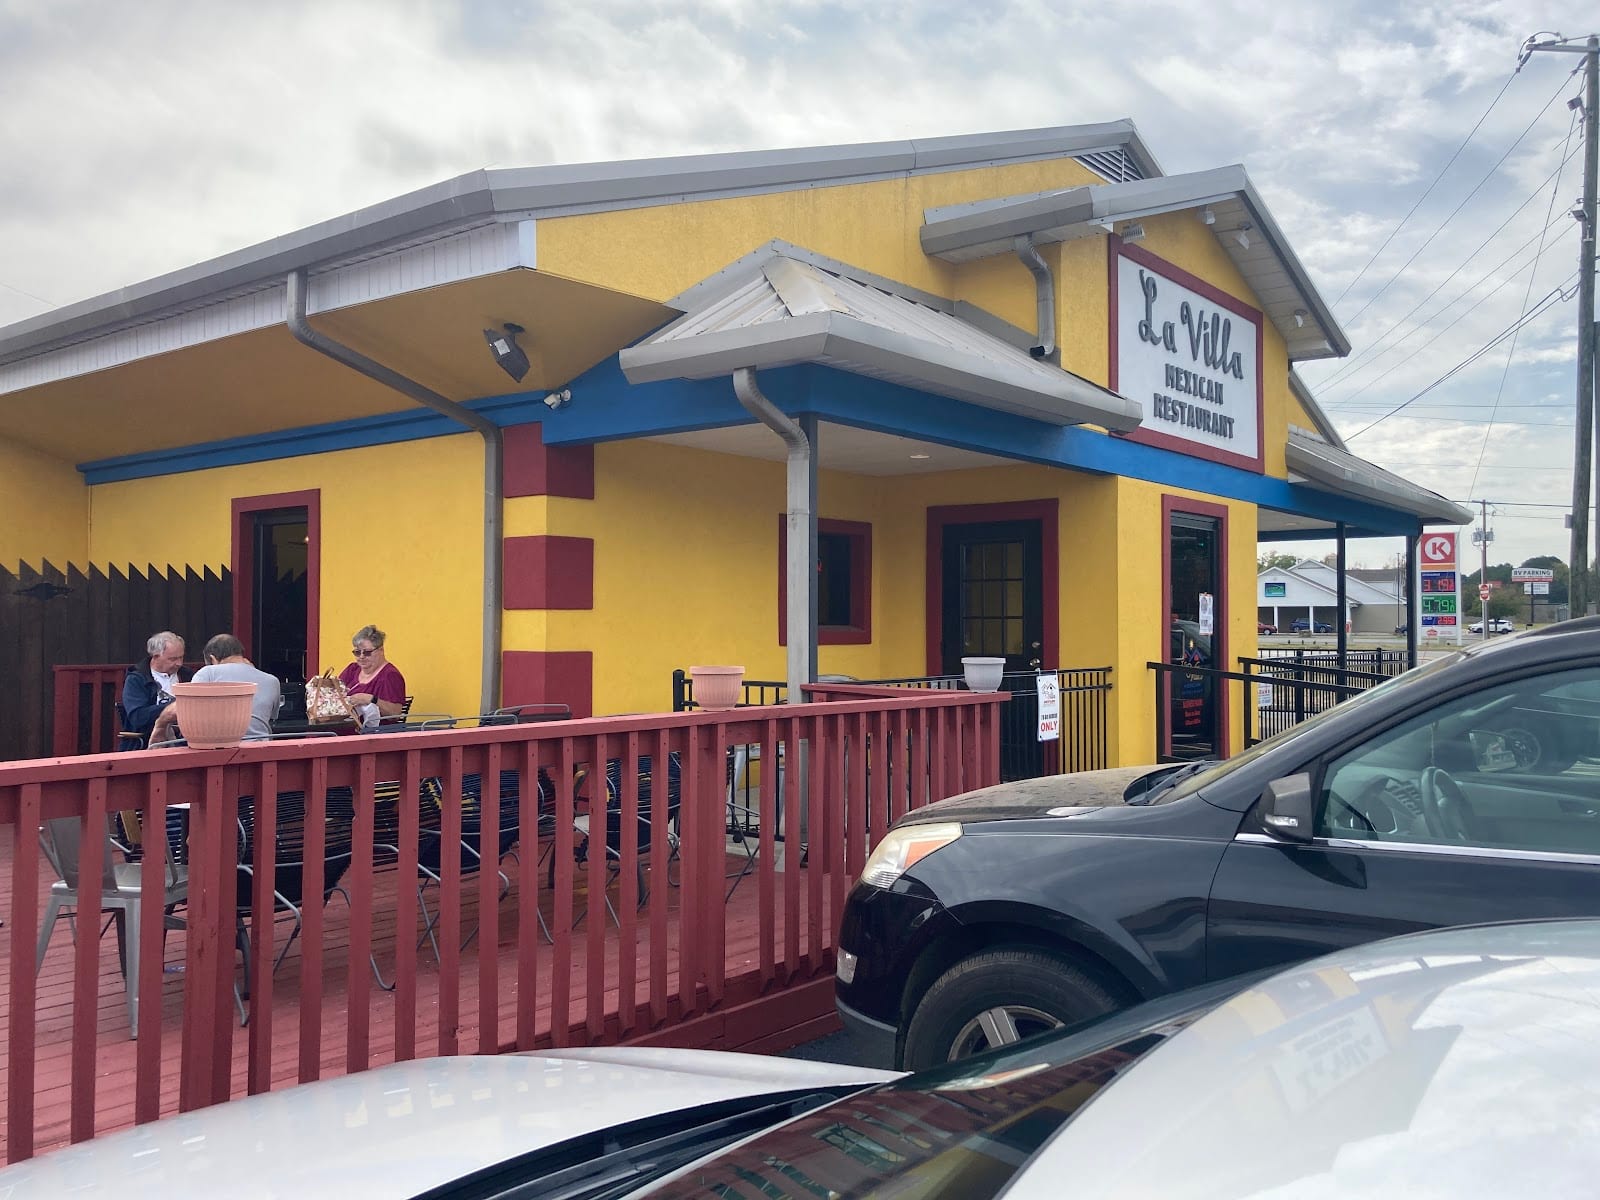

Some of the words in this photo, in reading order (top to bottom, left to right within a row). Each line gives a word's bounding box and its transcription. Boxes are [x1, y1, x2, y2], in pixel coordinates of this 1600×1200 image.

[1138, 269, 1177, 353] La
[1180, 301, 1244, 379] Villa
[1164, 363, 1224, 405] MEXICAN
[1153, 393, 1234, 438] RESTAURANT
[1041, 721, 1057, 732] ONLY
